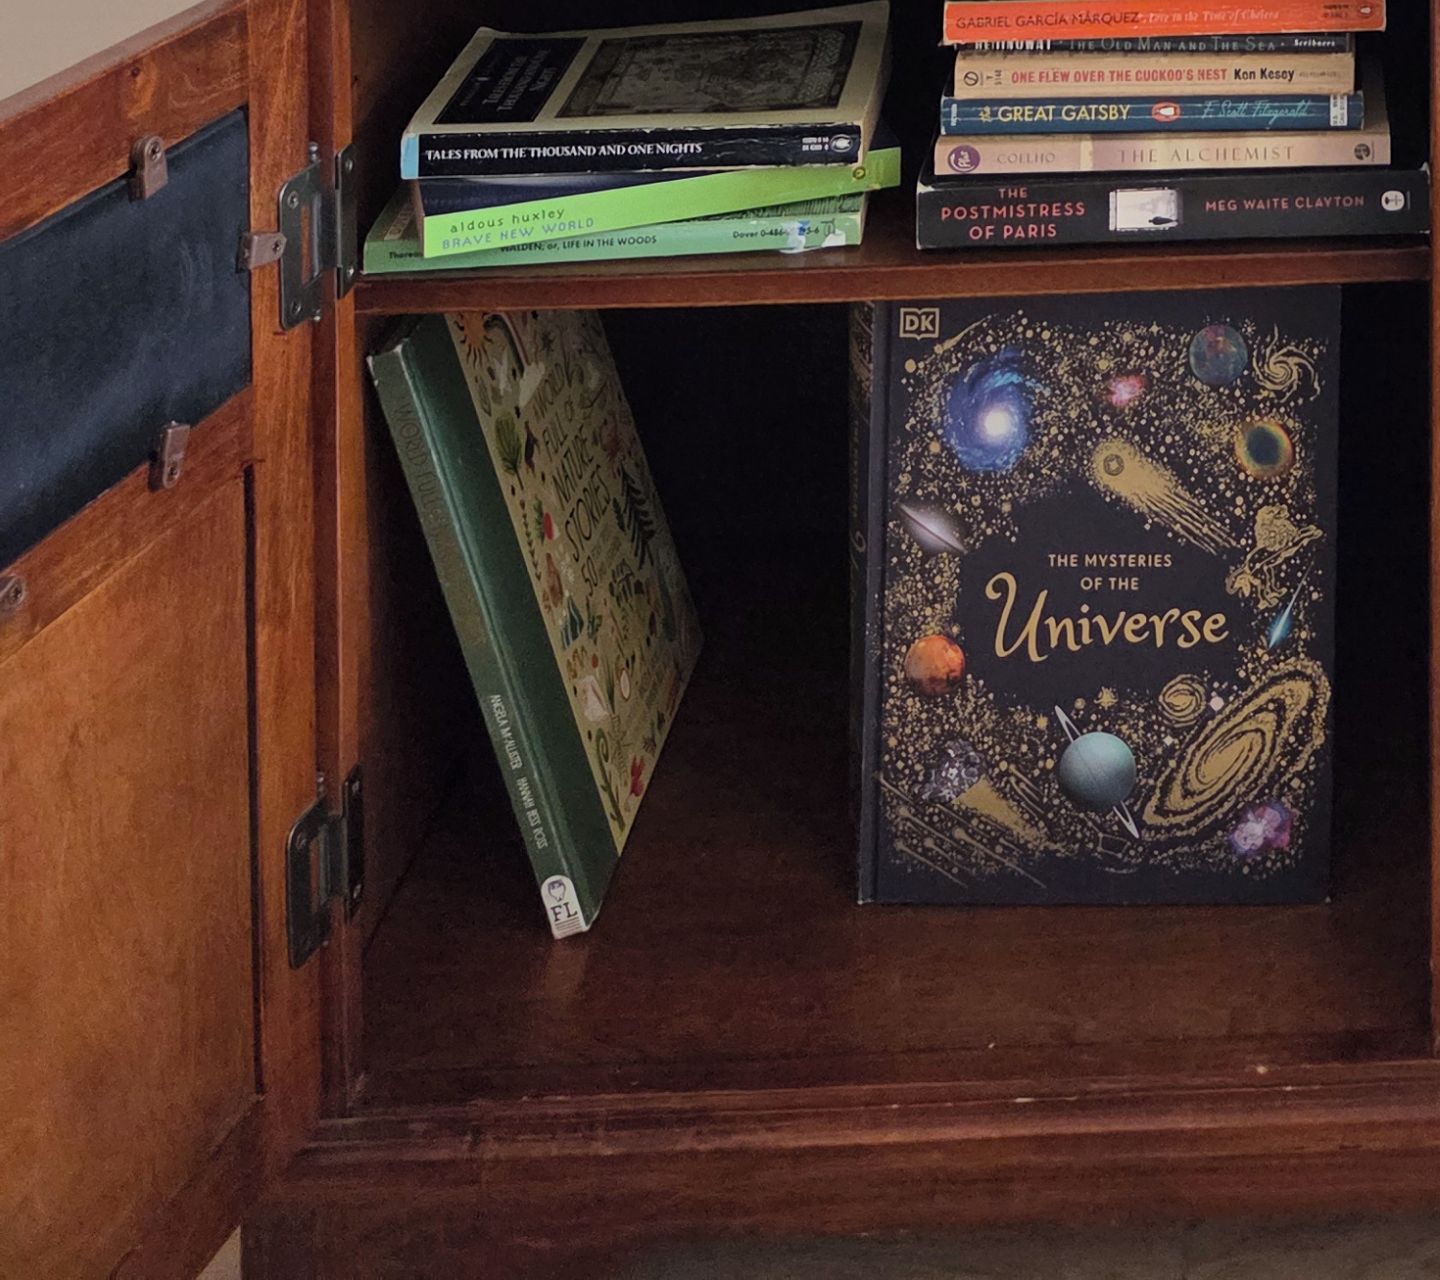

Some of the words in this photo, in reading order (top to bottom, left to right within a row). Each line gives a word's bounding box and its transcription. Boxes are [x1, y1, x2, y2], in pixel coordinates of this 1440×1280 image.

[956, 15, 1011, 29] GABRIEL
[1015, 11, 1067, 28] GARCÍA
[1071, 10, 1140, 26] MÁRQUEZ
[1068, 38, 1095, 50] THE
[1101, 37, 1133, 50] OLD
[1138, 37, 1172, 51] MAN
[1179, 40, 1207, 51] AND
[1211, 36, 1239, 51] THE
[1245, 36, 1277, 51] SEA
[1011, 71, 1035, 84] ONE
[1038, 70, 1069, 84] FLEW
[1073, 70, 1105, 83] OVER
[1108, 70, 1131, 82] THE
[1135, 68, 1194, 82] CUCKOO'S
[1197, 68, 1228, 81] NEST
[1233, 68, 1256, 81] Ken
[1260, 67, 1295, 83] Kesey
[998, 104, 1057, 123] GREAT
[1061, 104, 1130, 122] GATSBY
[426, 149, 462, 162] TALES
[463, 148, 499, 160] FROM
[501, 147, 527, 159] THE
[529, 145, 596, 158] THOUSAND
[598, 144, 626, 156] AND
[627, 143, 654, 155] ONE
[655, 142, 702, 155] NIGHTS
[997, 152, 1056, 165] COELHO
[1119, 150, 1159, 164] THE
[1171, 146, 1295, 164] ALCHEMIST
[998, 187, 1029, 199] THE
[941, 201, 1086, 222] POSTMISTRESS
[1205, 199, 1238, 212] MEG
[1243, 197, 1289, 211] WAITE
[1295, 195, 1365, 209] CLAYTON
[450, 216, 504, 234] aldous
[511, 208, 566, 225] huxley
[442, 232, 492, 251] BRAVE
[500, 226, 535, 241] NEW
[542, 218, 594, 234] WORLD
[969, 225, 995, 240] OF
[1003, 223, 1057, 239] PARIS
[562, 239, 582, 250] LIFE
[583, 238, 595, 248] IN
[596, 236, 614, 247] THE
[617, 235, 658, 246] WOODS
[904, 315, 934, 333] DK
[551, 423, 595, 512] NATURE
[564, 463, 611, 562] STORIES
[1048, 553, 1079, 568] THE
[1084, 552, 1173, 568] MYSTERIES
[580, 555, 599, 597] 50
[1080, 576, 1104, 591] OF
[1109, 575, 1140, 590] THE
[984, 571, 1230, 663] Universe
[516, 776, 532, 808] HANNAH
[525, 805, 540, 828] BESS
[532, 825, 548, 850] ROSS
[551, 901, 578, 923] FL
